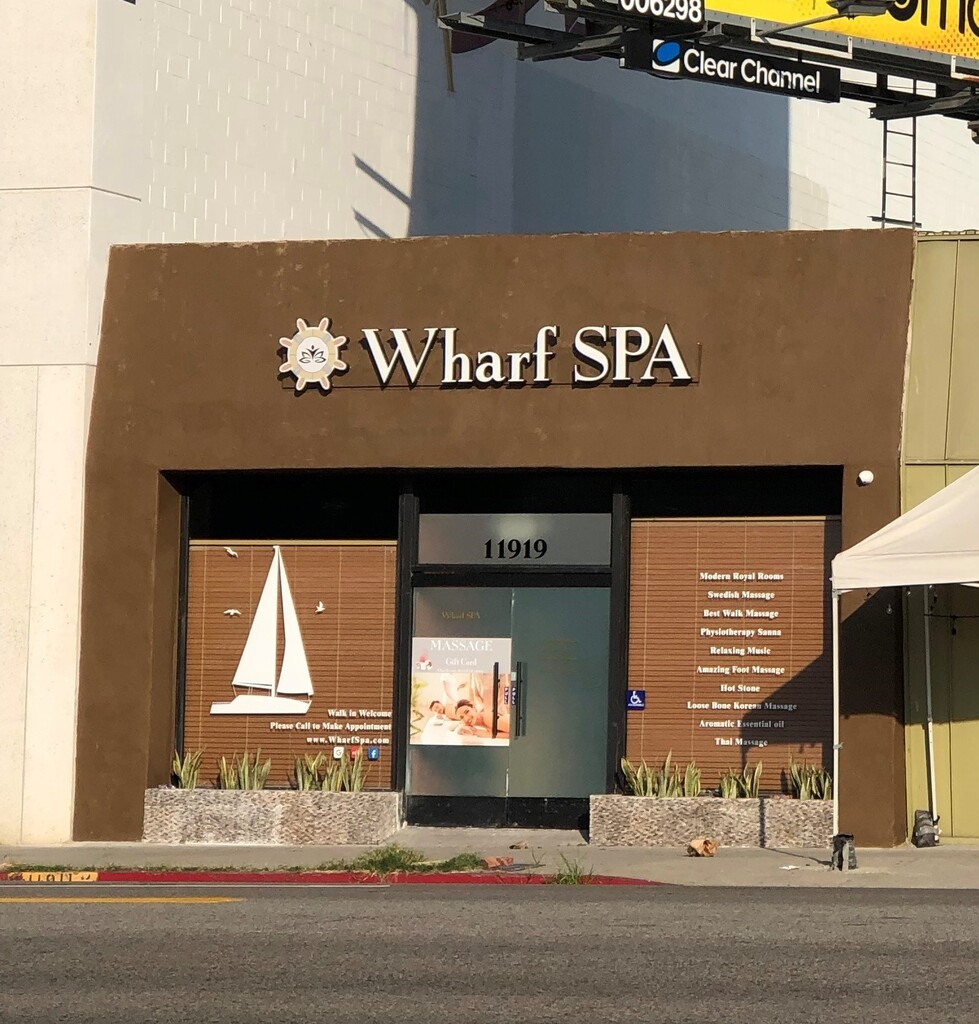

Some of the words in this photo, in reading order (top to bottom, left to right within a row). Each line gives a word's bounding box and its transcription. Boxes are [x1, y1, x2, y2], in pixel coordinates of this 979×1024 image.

[683, 48, 738, 80] Clear
[740, 59, 821, 94] Channel
[362, 325, 558, 384] Wharf
[573, 323, 691, 383] SPA
[484, 538, 547, 559] 11919
[700, 572, 731, 580] Modern
[733, 572, 755, 581] Royal
[757, 572, 784, 580] Rooms
[707, 591, 740, 599] Swedish
[741, 591, 775, 600] Massage
[703, 609, 720, 617] Best
[722, 609, 743, 617] Walk
[745, 609, 779, 619] Massage
[700, 628, 755, 637] Physiotherapy
[430, 640, 493, 652] MASSAGE
[710, 646, 745, 656] Relaxing
[747, 646, 771, 654] Music
[445, 657, 460, 666] Gift
[460, 657, 477, 666] Card
[696, 665, 730, 675] Amazing
[732, 665, 750, 673] Foot
[751, 665, 785, 675] Massage
[720, 684, 735, 692] Hot
[737, 684, 760, 692] Stone
[687, 701, 709, 709] Loose
[711, 701, 731, 709] Bone
[733, 701, 762, 709] Korean
[764, 702, 797, 711] Massage
[327, 709, 348, 717] Walk
[349, 709, 357, 717] in
[359, 709, 392, 717] Welcome
[270, 722, 293, 730] Please
[295, 722, 311, 730] Call
[312, 722, 321, 730] to
[322, 722, 343, 730] Make
[345, 722, 392, 731] Appointment
[699, 720, 735, 728] Aromatic
[737, 720, 771, 728] Essential
[773, 720, 785, 728] oil
[306, 736, 390, 745] www.WharfSpa.com
[714, 738, 733, 746] Thai
[735, 738, 768, 747] Massage
